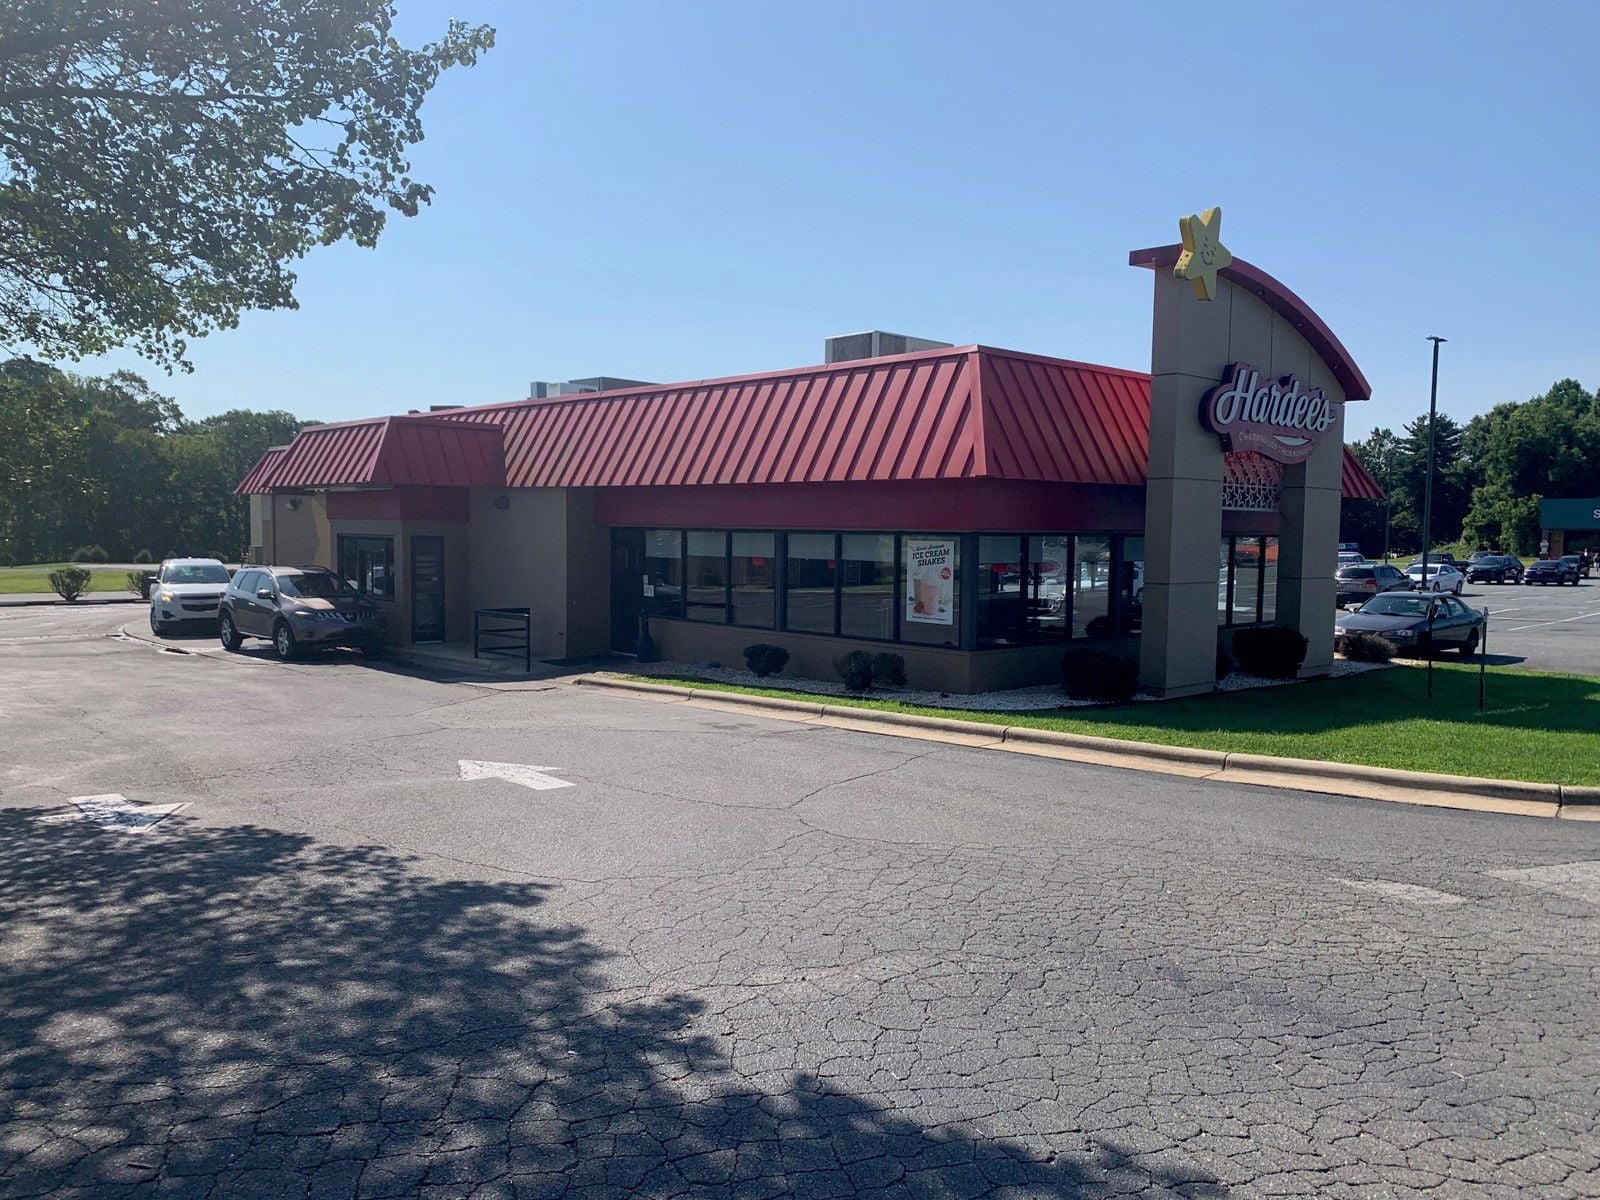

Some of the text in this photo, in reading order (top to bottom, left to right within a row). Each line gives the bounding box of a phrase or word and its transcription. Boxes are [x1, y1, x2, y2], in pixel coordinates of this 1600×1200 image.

[1216, 370, 1336, 432] Hardee's
[912, 549, 950, 560] ICE CREAM
[917, 557, 946, 567] SHAKES
